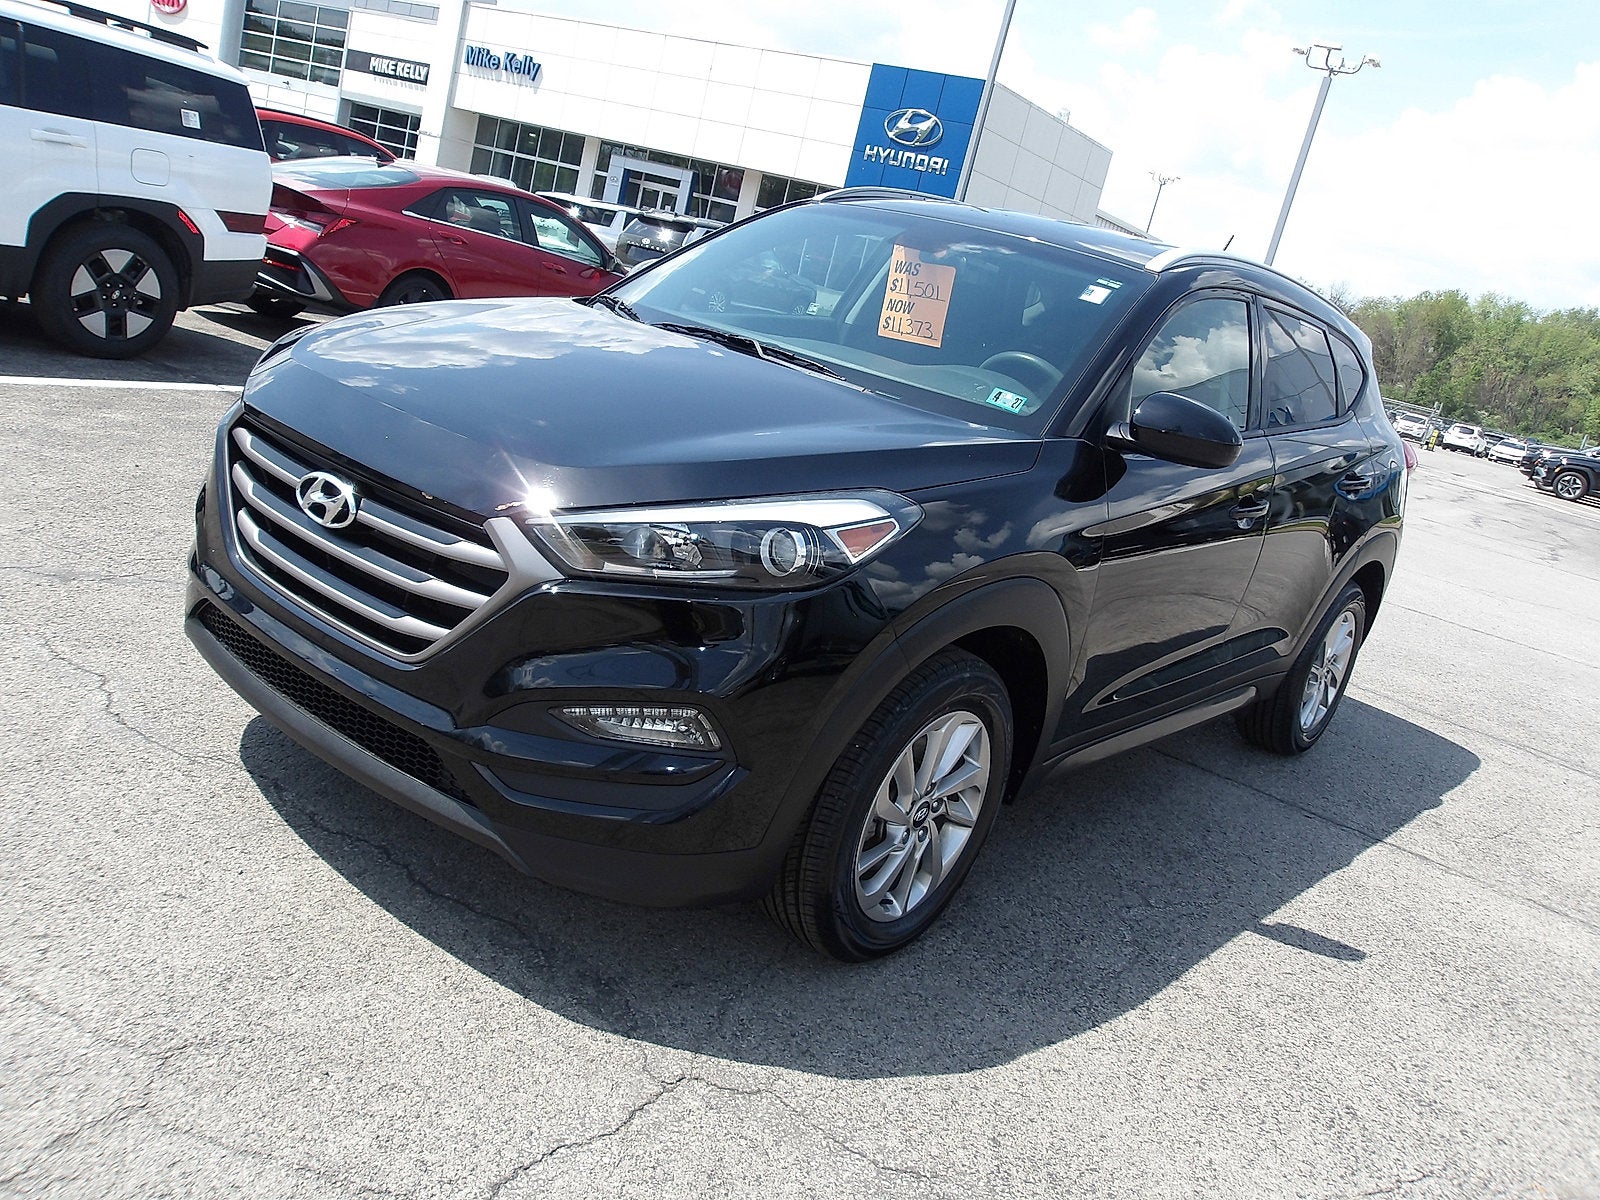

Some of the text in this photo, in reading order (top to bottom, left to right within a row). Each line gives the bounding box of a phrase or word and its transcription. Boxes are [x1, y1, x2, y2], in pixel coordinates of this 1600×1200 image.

[369, 56, 429, 81] MIKE KELLY
[464, 45, 541, 82] Mike Kelly
[863, 144, 950, 176] HYUNDAI
[894, 260, 921, 276] WAS
[886, 298, 915, 315] NOW
[882, 315, 934, 339] $11,373
